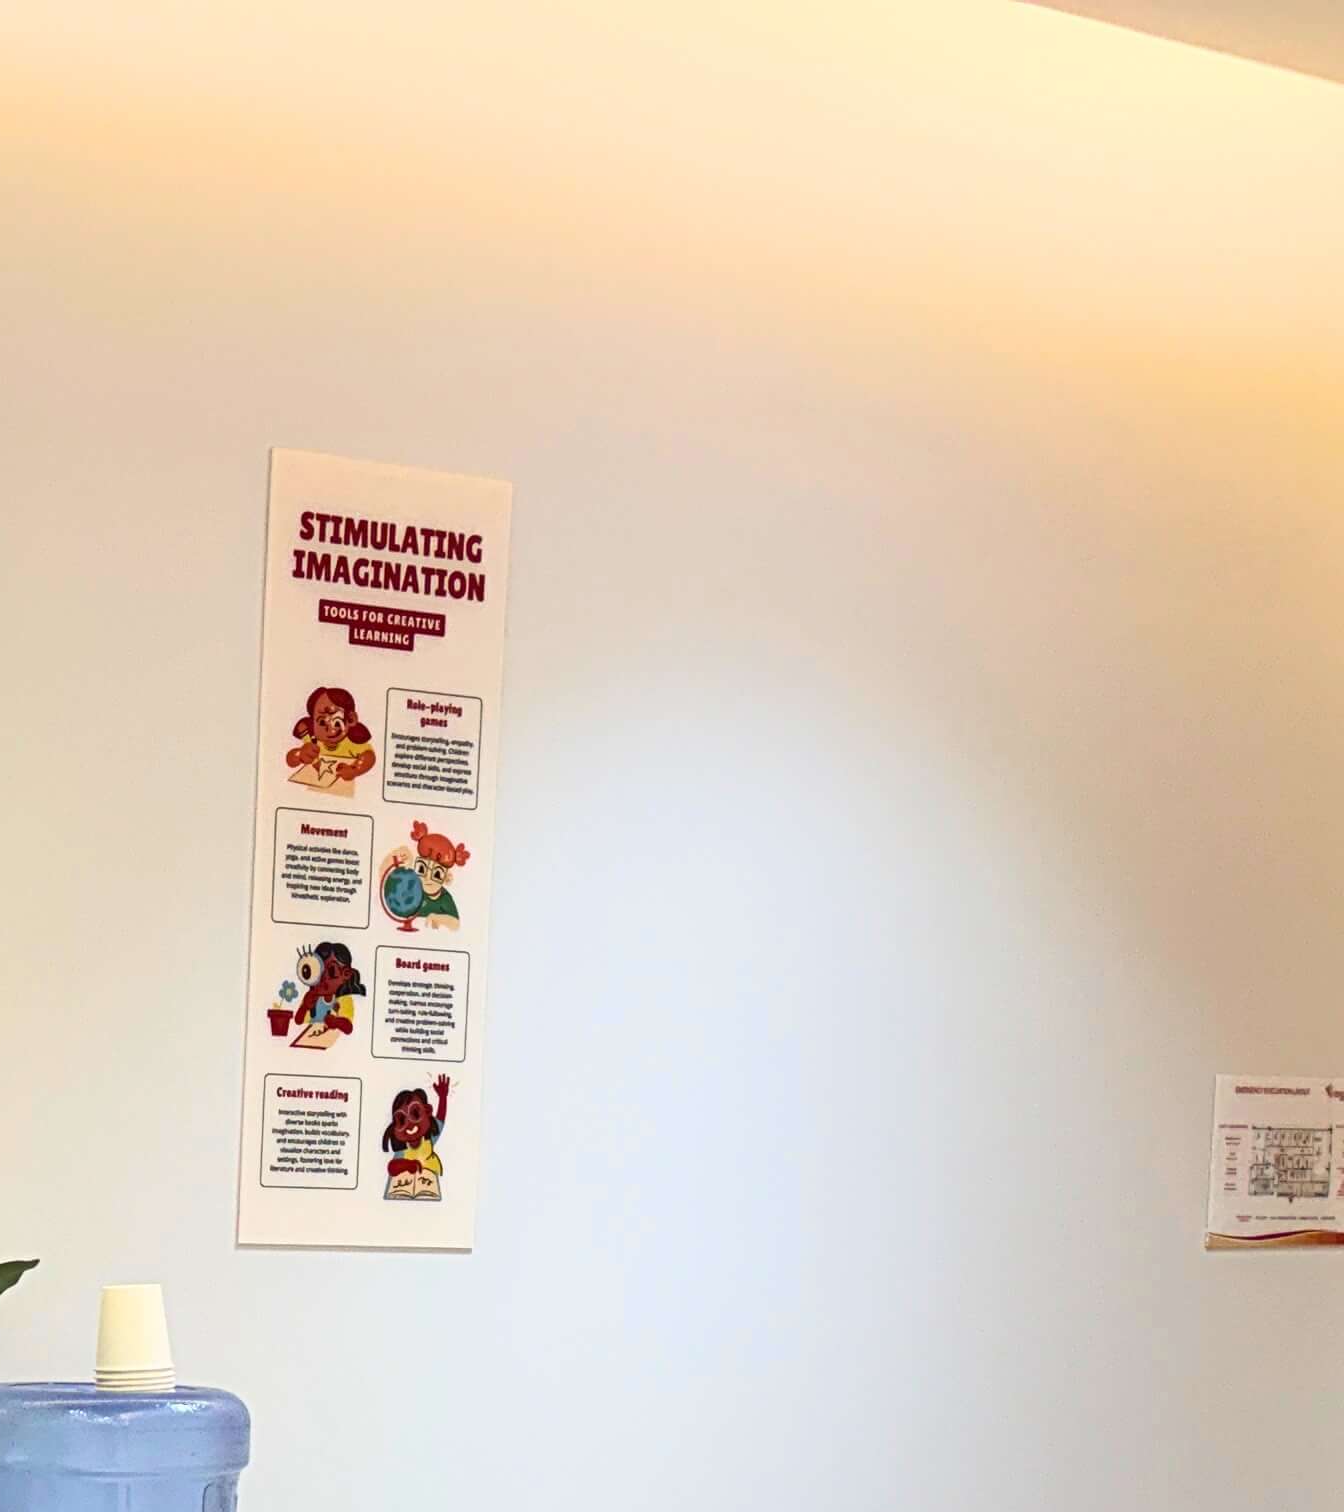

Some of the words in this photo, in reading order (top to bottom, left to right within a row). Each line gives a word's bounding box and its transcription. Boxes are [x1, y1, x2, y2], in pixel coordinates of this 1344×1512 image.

[299, 511, 482, 564] STIMULATING
[292, 549, 485, 602] IMAGINATION
[323, 605, 359, 621] TOOLS
[362, 609, 384, 624] FOR
[387, 613, 441, 631] CREATIVE
[353, 628, 410, 646] LEARNING
[407, 698, 462, 717] Role-playing
[420, 717, 448, 728] games
[301, 823, 348, 838] Movement
[396, 958, 421, 969] Board
[423, 962, 450, 972] games
[277, 1086, 313, 1099] Creative
[315, 1089, 348, 1102] reading
